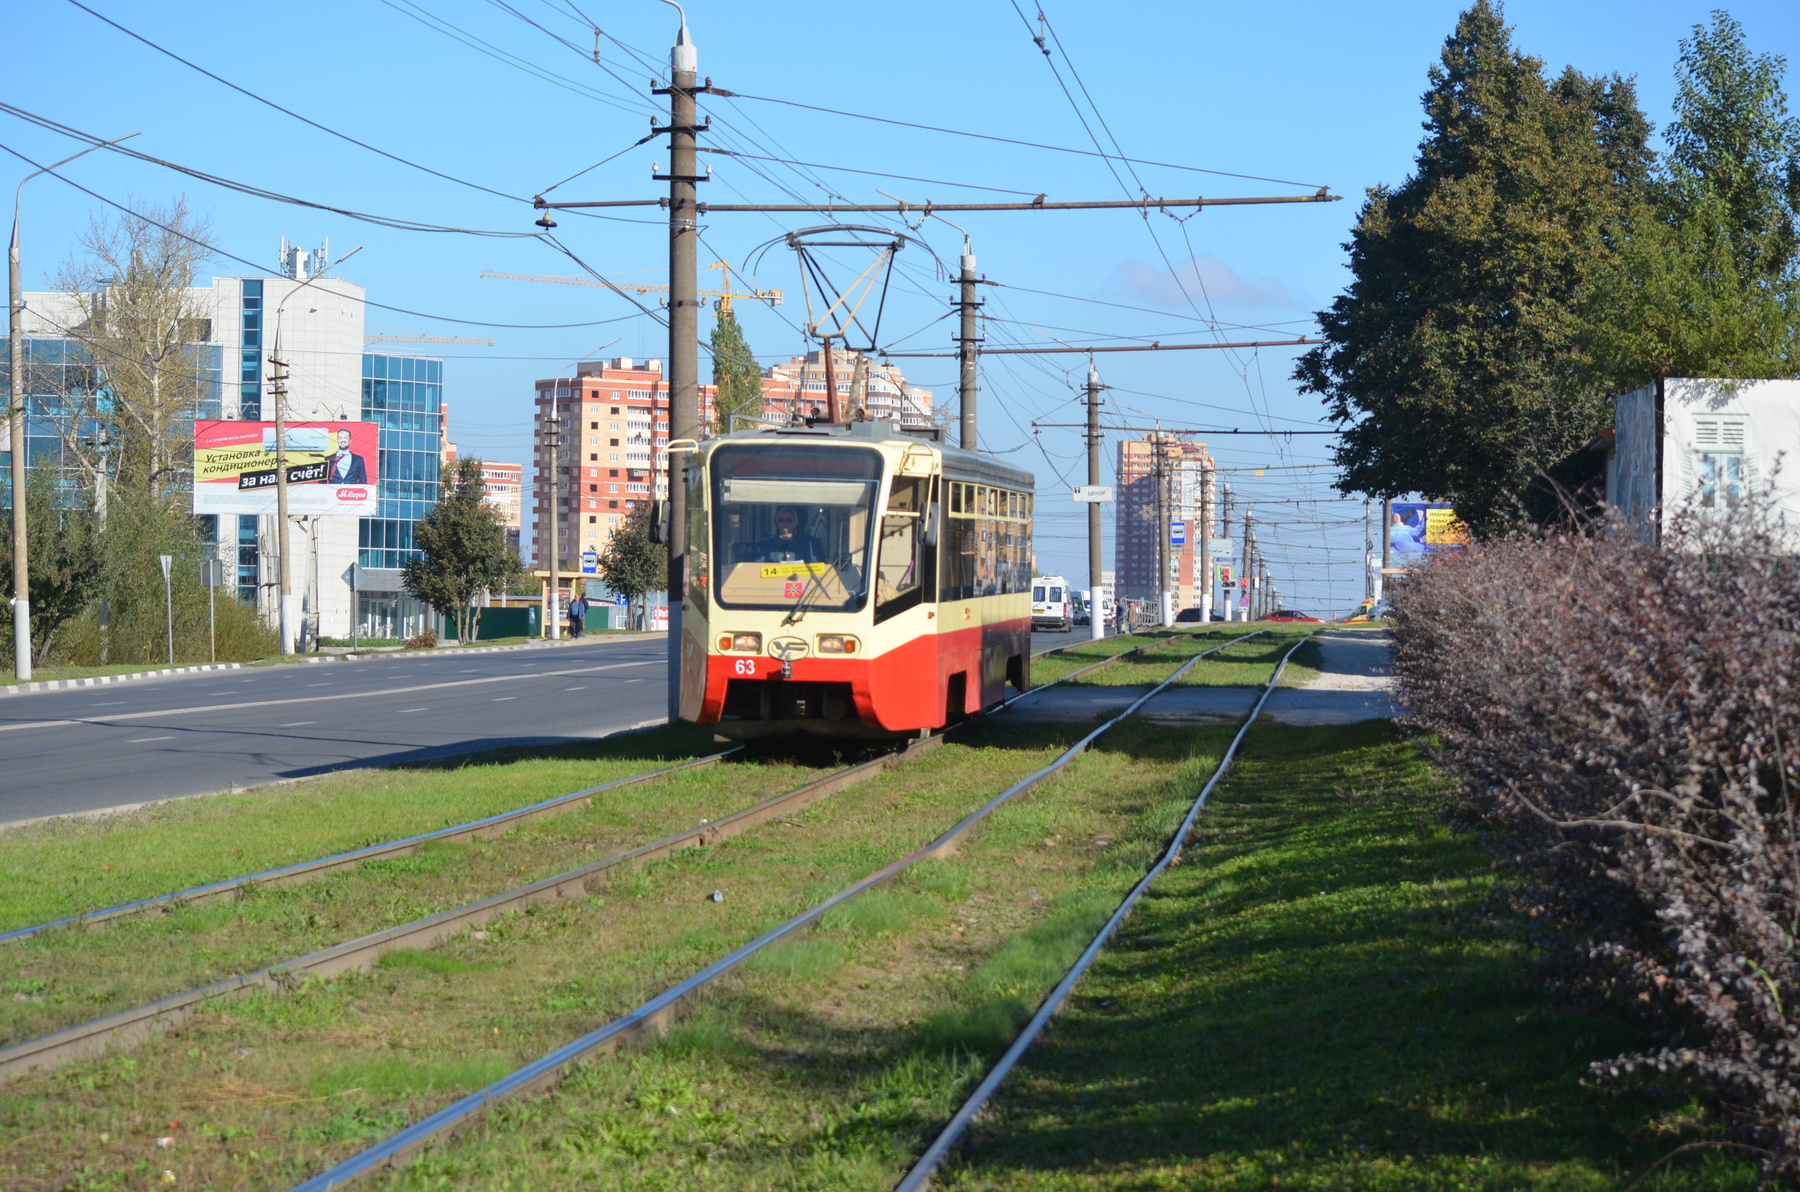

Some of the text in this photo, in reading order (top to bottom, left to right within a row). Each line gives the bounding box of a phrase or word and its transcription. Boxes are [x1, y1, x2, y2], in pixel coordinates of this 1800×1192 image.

[205, 449, 261, 463] Установка
[203, 457, 279, 474] кондиционер
[241, 464, 326, 487] за на счёт!
[763, 568, 777, 576] 14
[735, 659, 756, 675] 63
